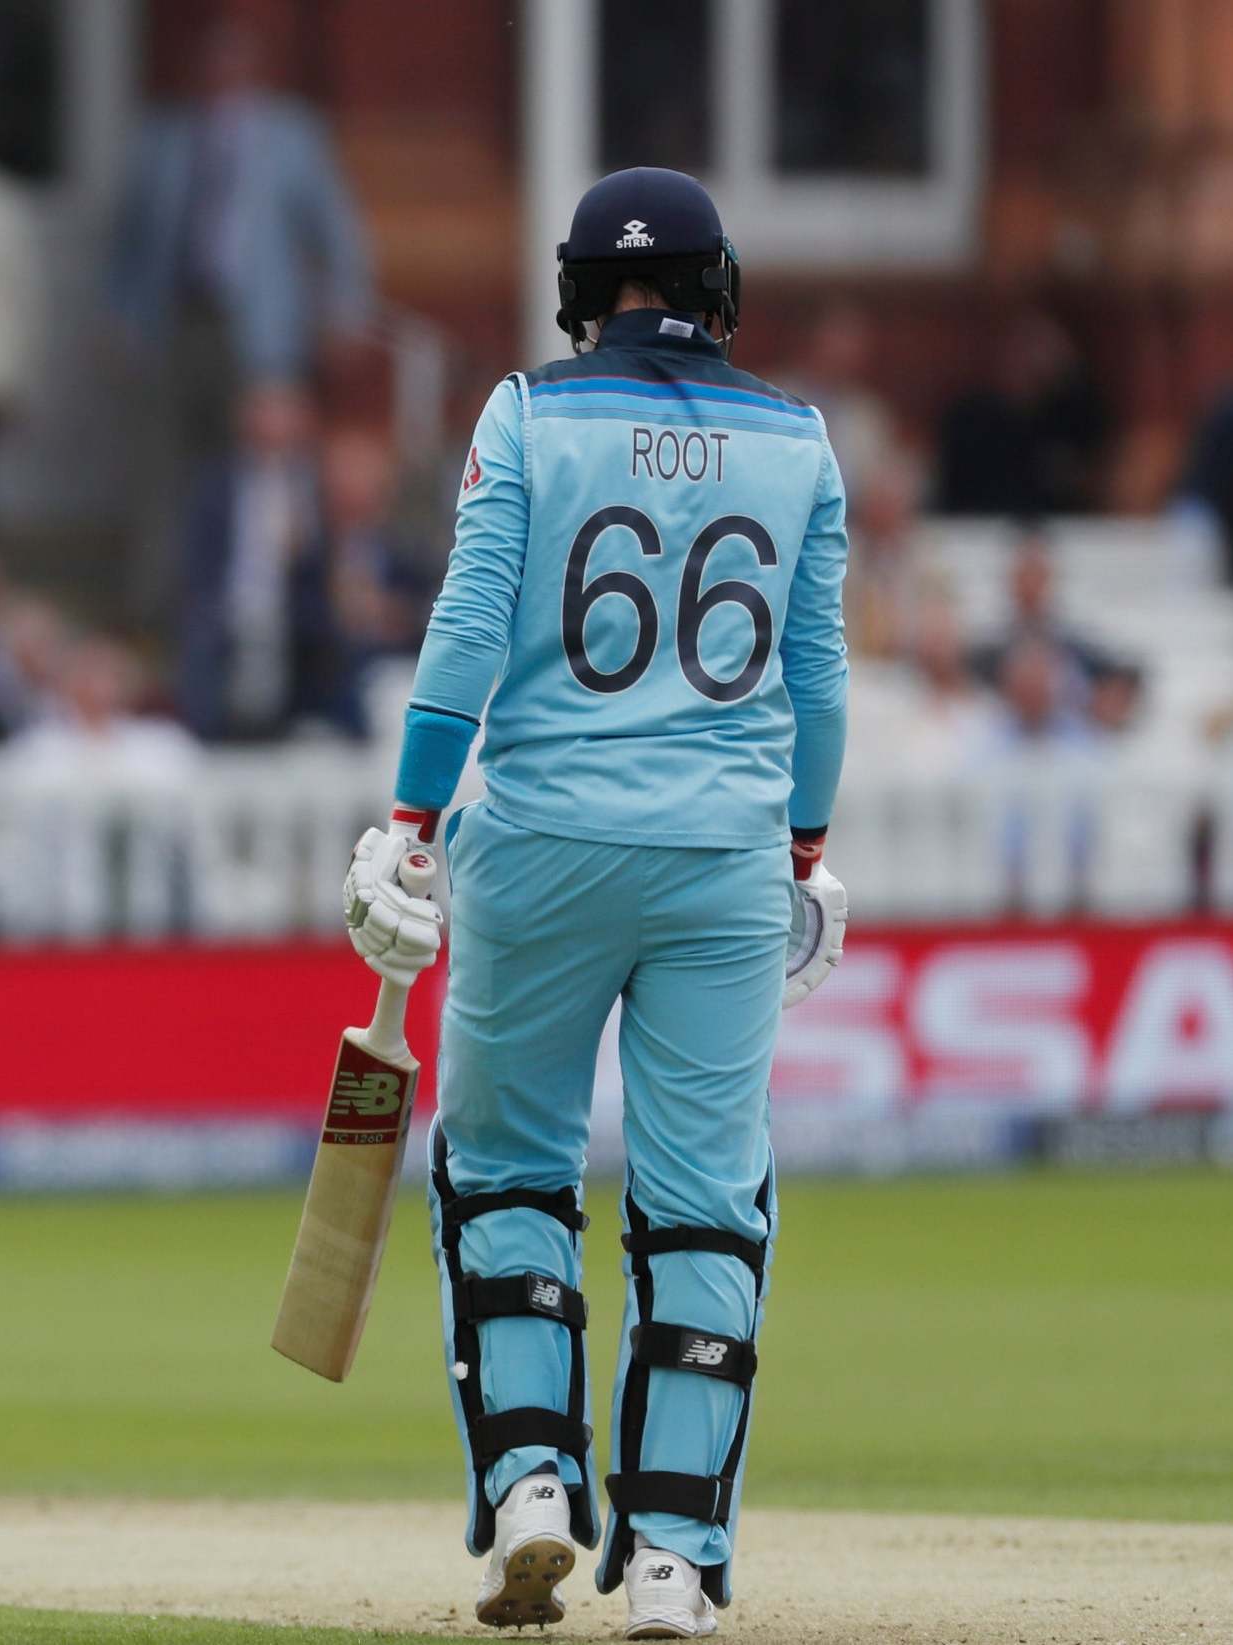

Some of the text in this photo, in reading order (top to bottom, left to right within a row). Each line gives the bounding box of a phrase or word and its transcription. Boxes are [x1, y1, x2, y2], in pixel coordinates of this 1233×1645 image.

[616, 236, 655, 249] SHREY
[631, 427, 729, 482] ROOT
[561, 504, 779, 704] 66
[331, 1071, 401, 1116] NB
[334, 1132, 349, 1143] TC
